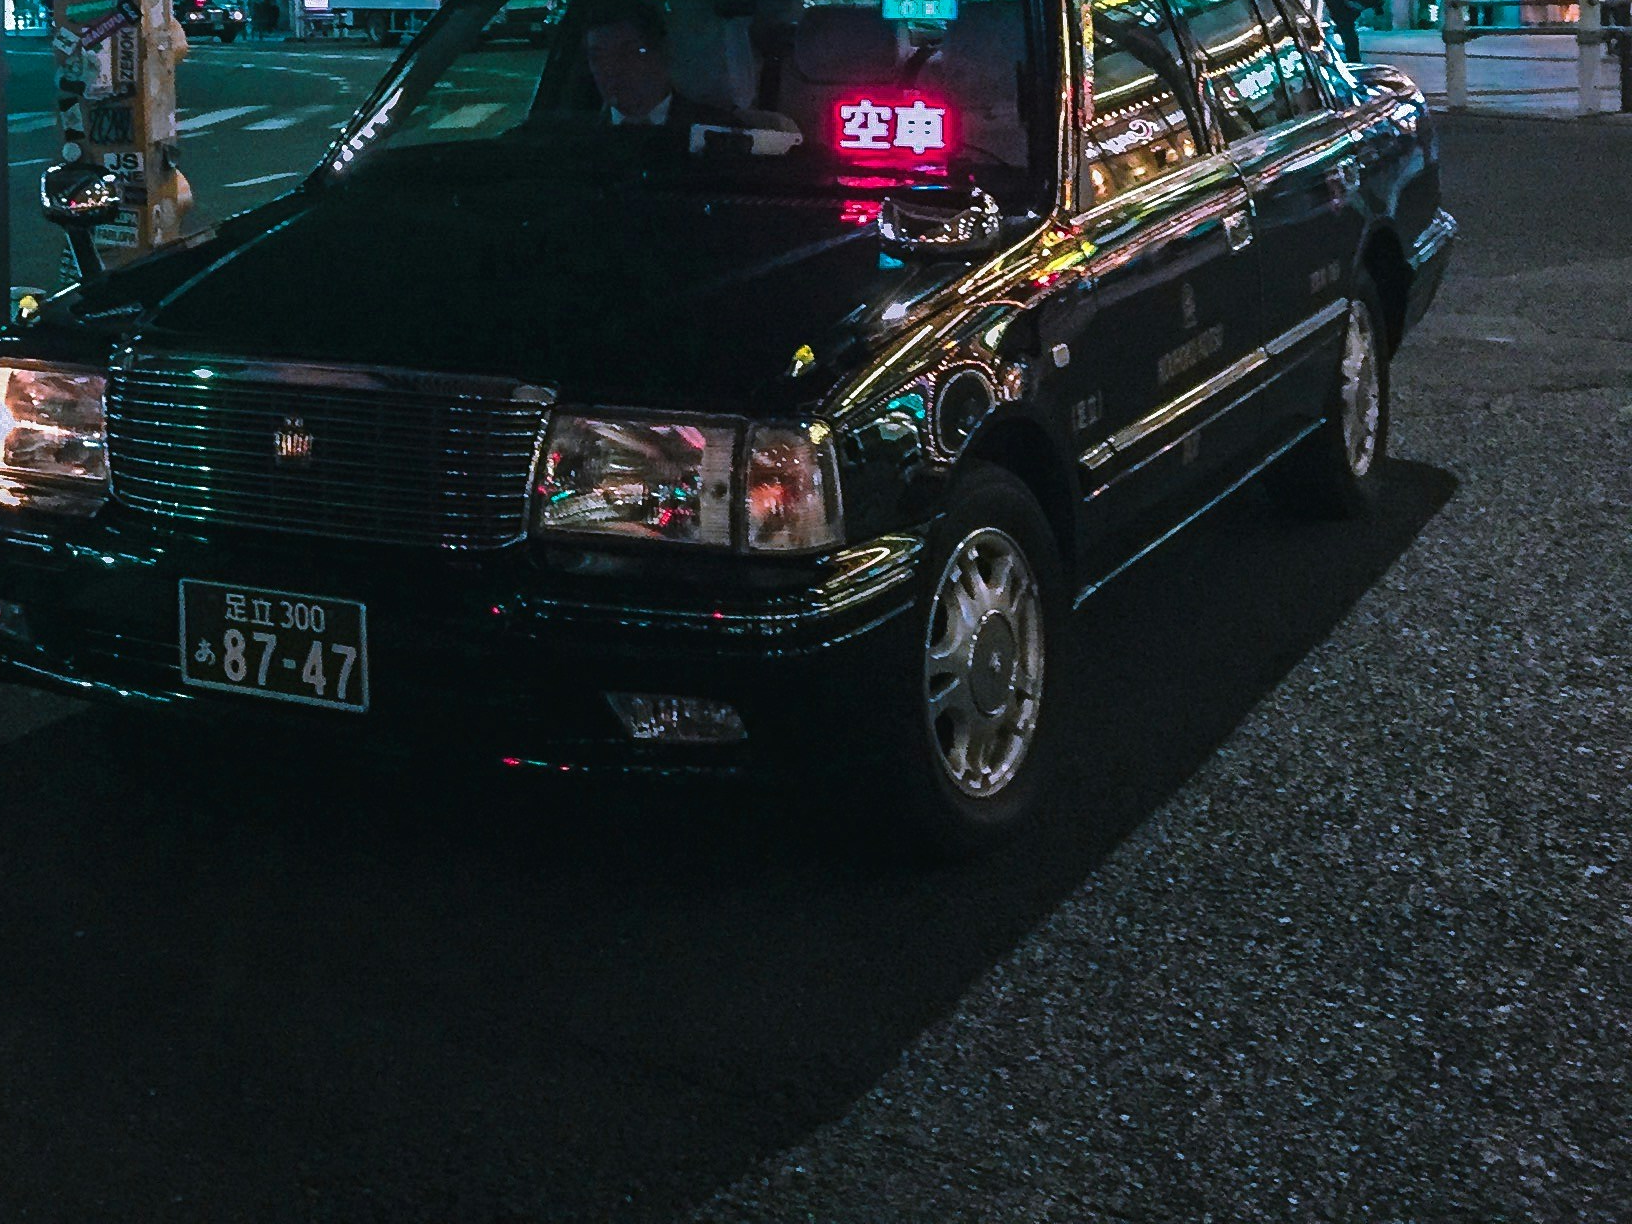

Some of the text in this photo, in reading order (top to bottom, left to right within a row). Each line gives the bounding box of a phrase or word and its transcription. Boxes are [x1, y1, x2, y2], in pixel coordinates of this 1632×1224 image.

[840, 99, 946, 155] 空車
[225, 593, 326, 633] 足立 300
[194, 629, 357, 699] あ 87-47
